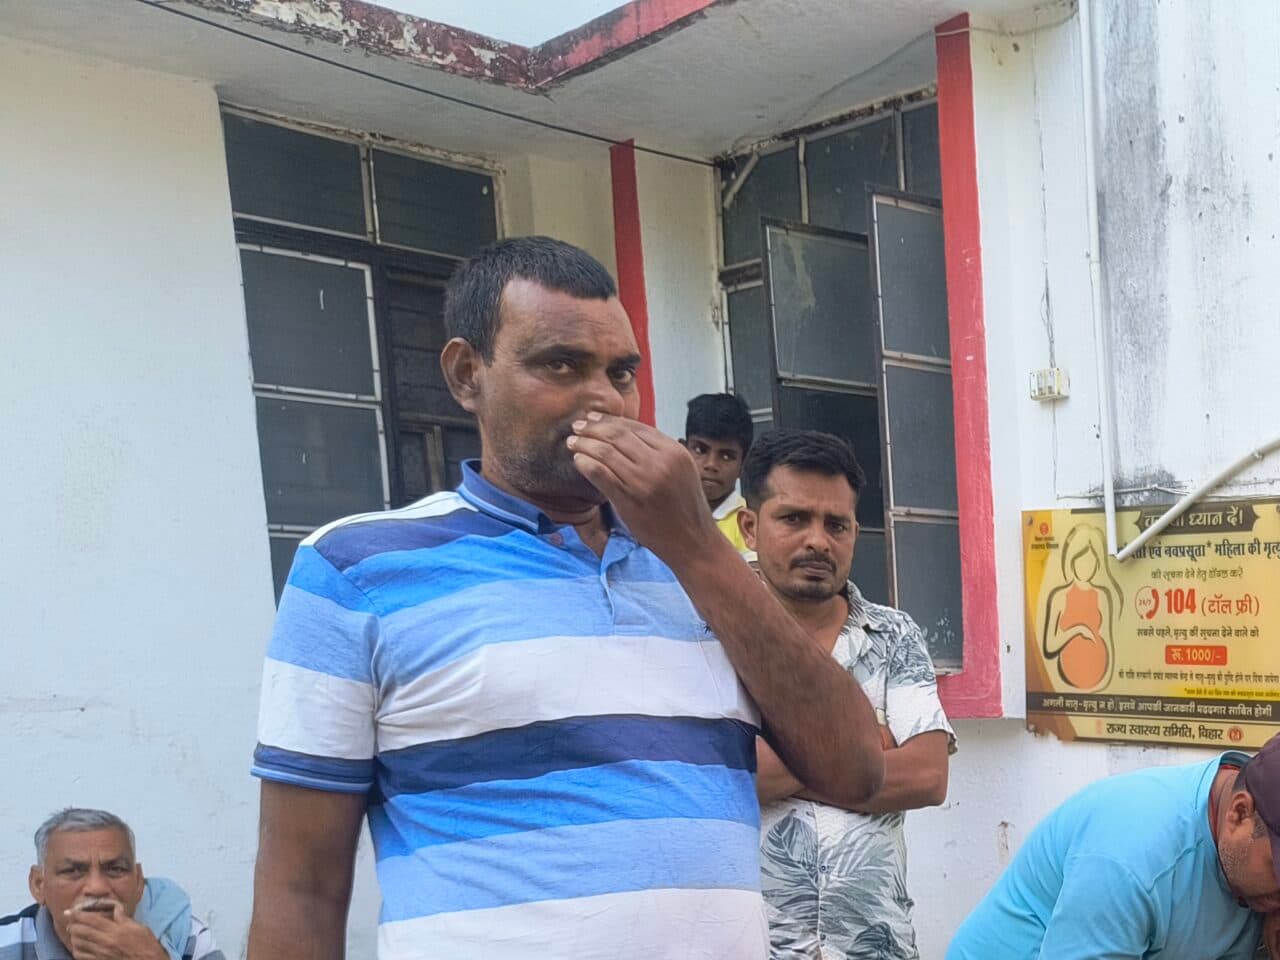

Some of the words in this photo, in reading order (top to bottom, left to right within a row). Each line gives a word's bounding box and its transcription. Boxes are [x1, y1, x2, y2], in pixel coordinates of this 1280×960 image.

[1189, 511, 1222, 526] ध्यान
[1215, 539, 1245, 559] महिला
[1248, 540, 1260, 556] की
[1164, 588, 1197, 614] 104
[1106, 721, 1128, 734] राज्य
